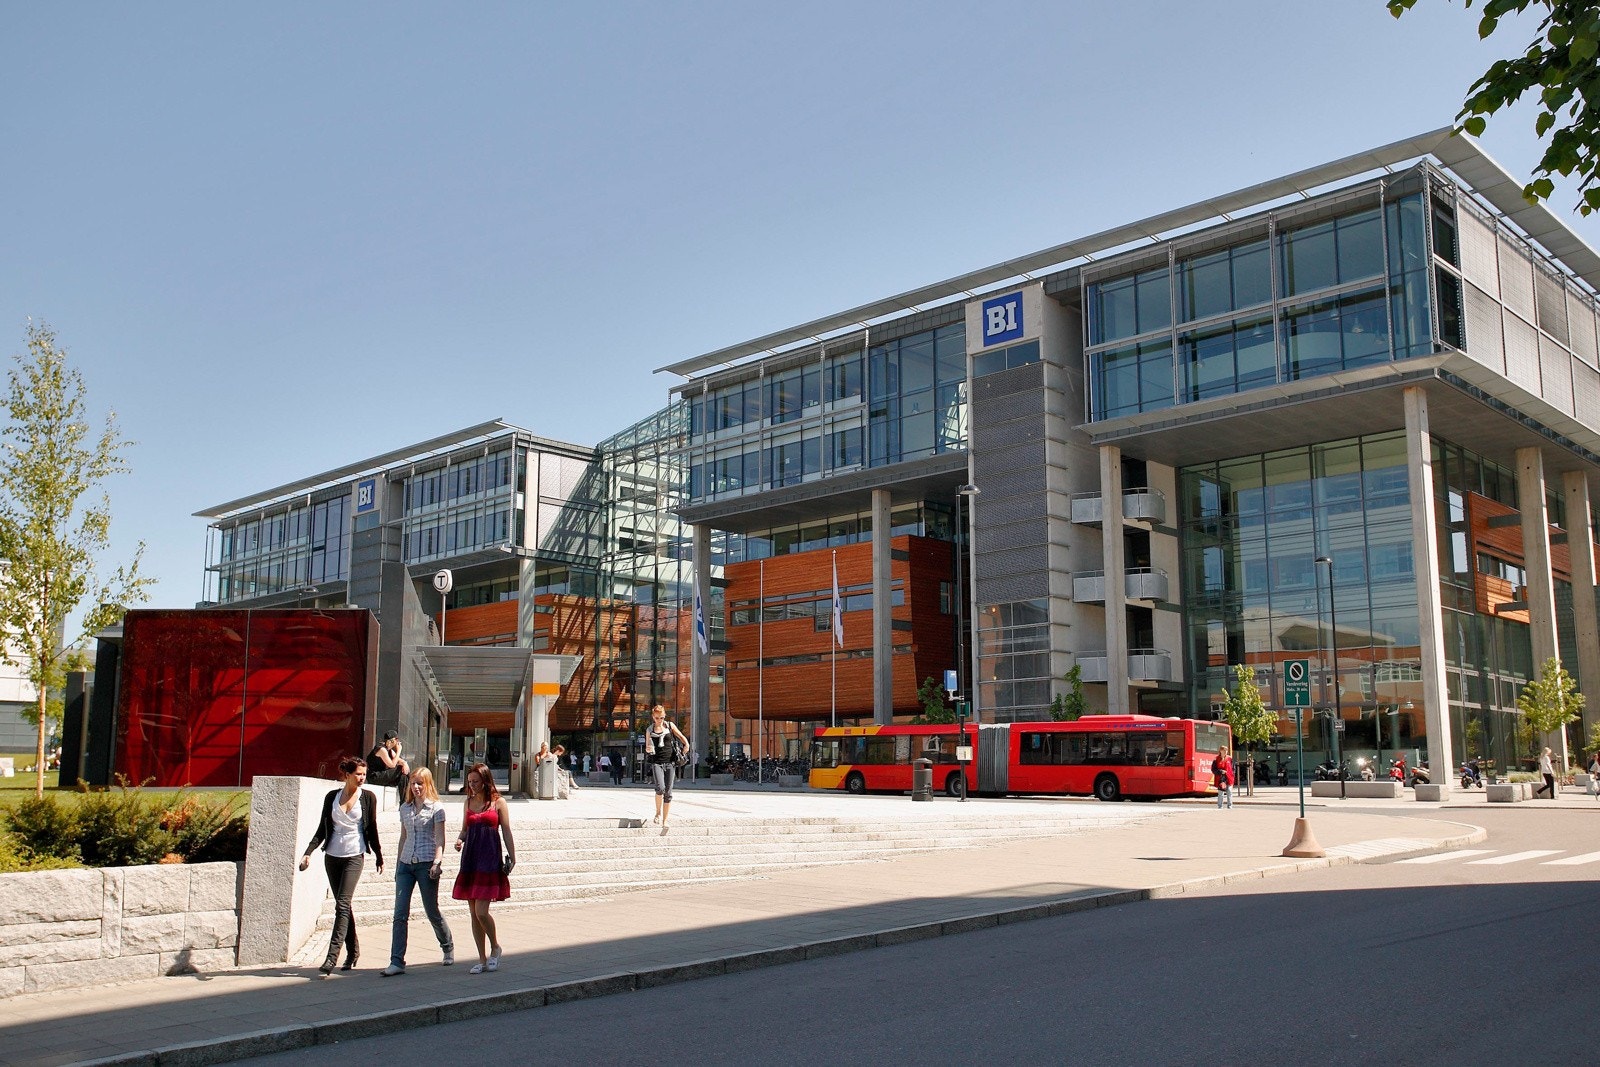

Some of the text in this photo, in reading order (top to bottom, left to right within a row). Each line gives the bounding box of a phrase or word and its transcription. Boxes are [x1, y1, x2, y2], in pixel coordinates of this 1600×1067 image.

[986, 301, 1017, 336] BI
[358, 485, 372, 506] BI
[437, 576, 446, 587] T
